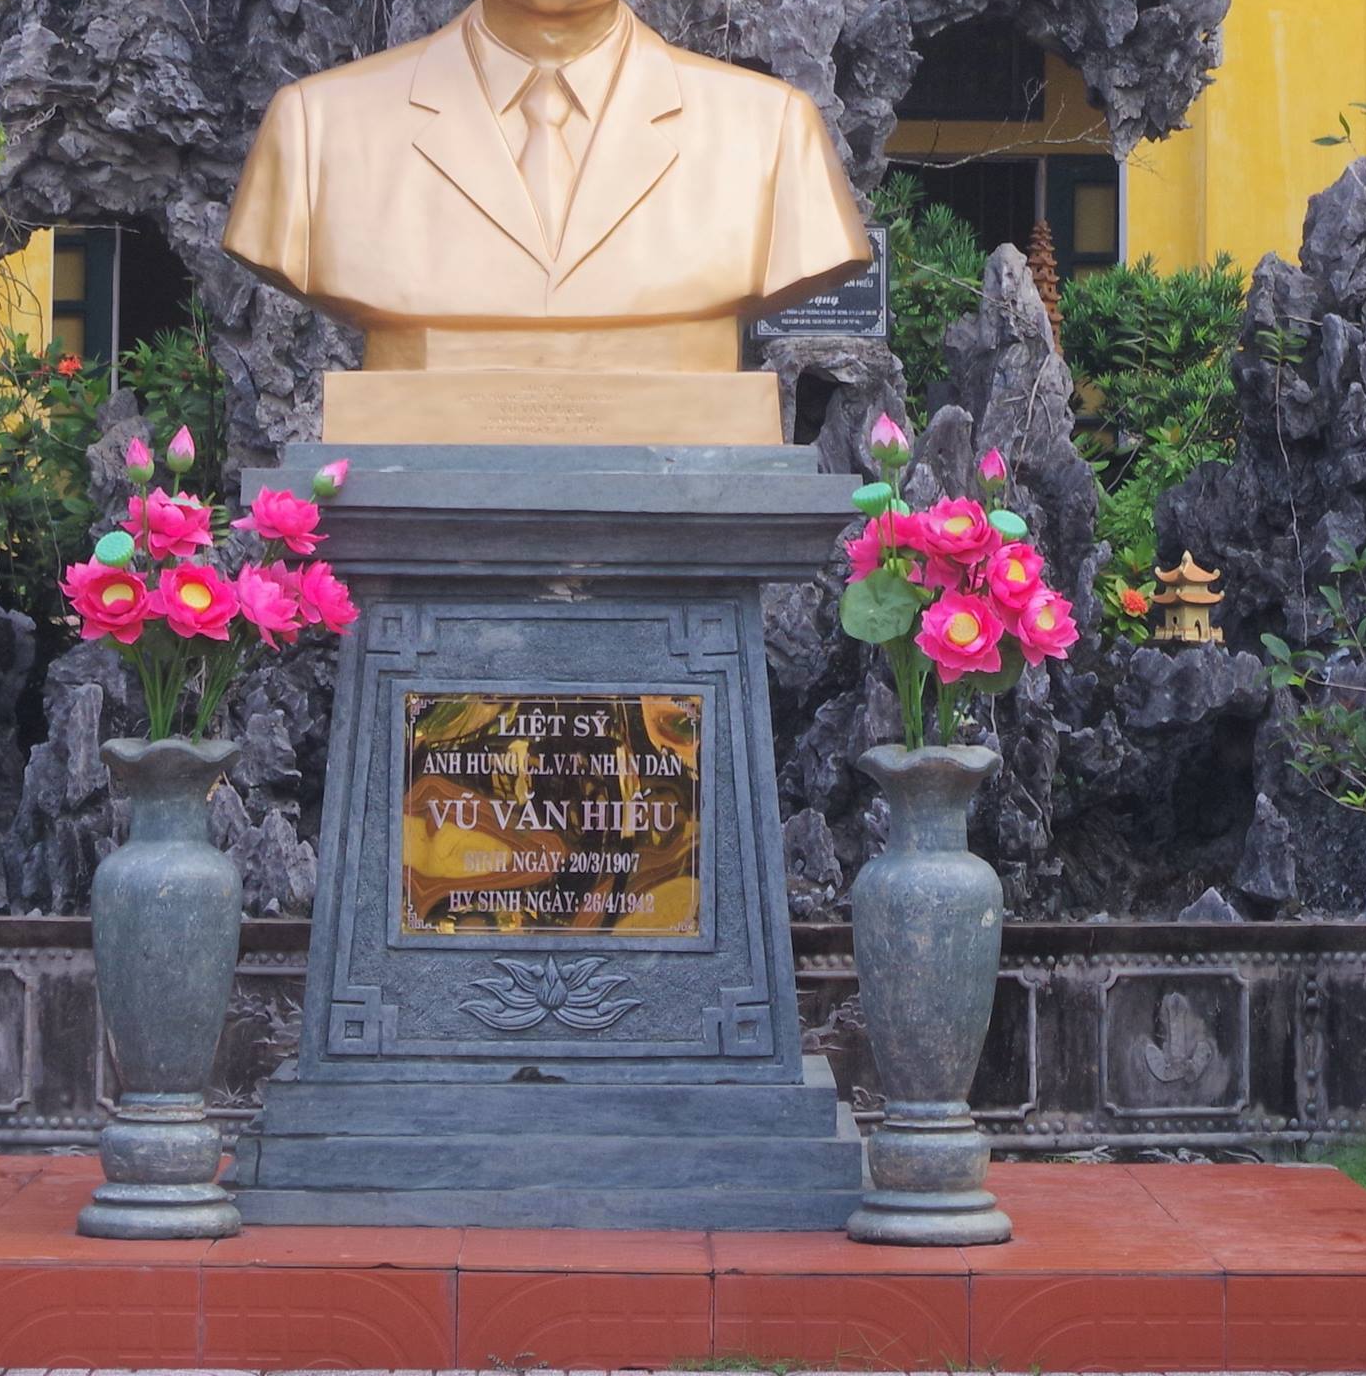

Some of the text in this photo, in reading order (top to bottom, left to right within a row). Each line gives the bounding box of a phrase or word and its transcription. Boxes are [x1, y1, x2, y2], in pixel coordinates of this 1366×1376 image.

[497, 708, 610, 742] LIỆT SỸ
[423, 752, 462, 775] ANH
[466, 745, 519, 776] HÙNG
[646, 749, 683, 777] DÂN
[427, 789, 679, 832] VŨ VĂN HIẾU
[463, 844, 640, 874] SINH NGÀY: 20/3/1907
[477, 891, 522, 913] SINH
[525, 885, 579, 913] NGÀY:
[583, 891, 655, 914] 26/4/1942
